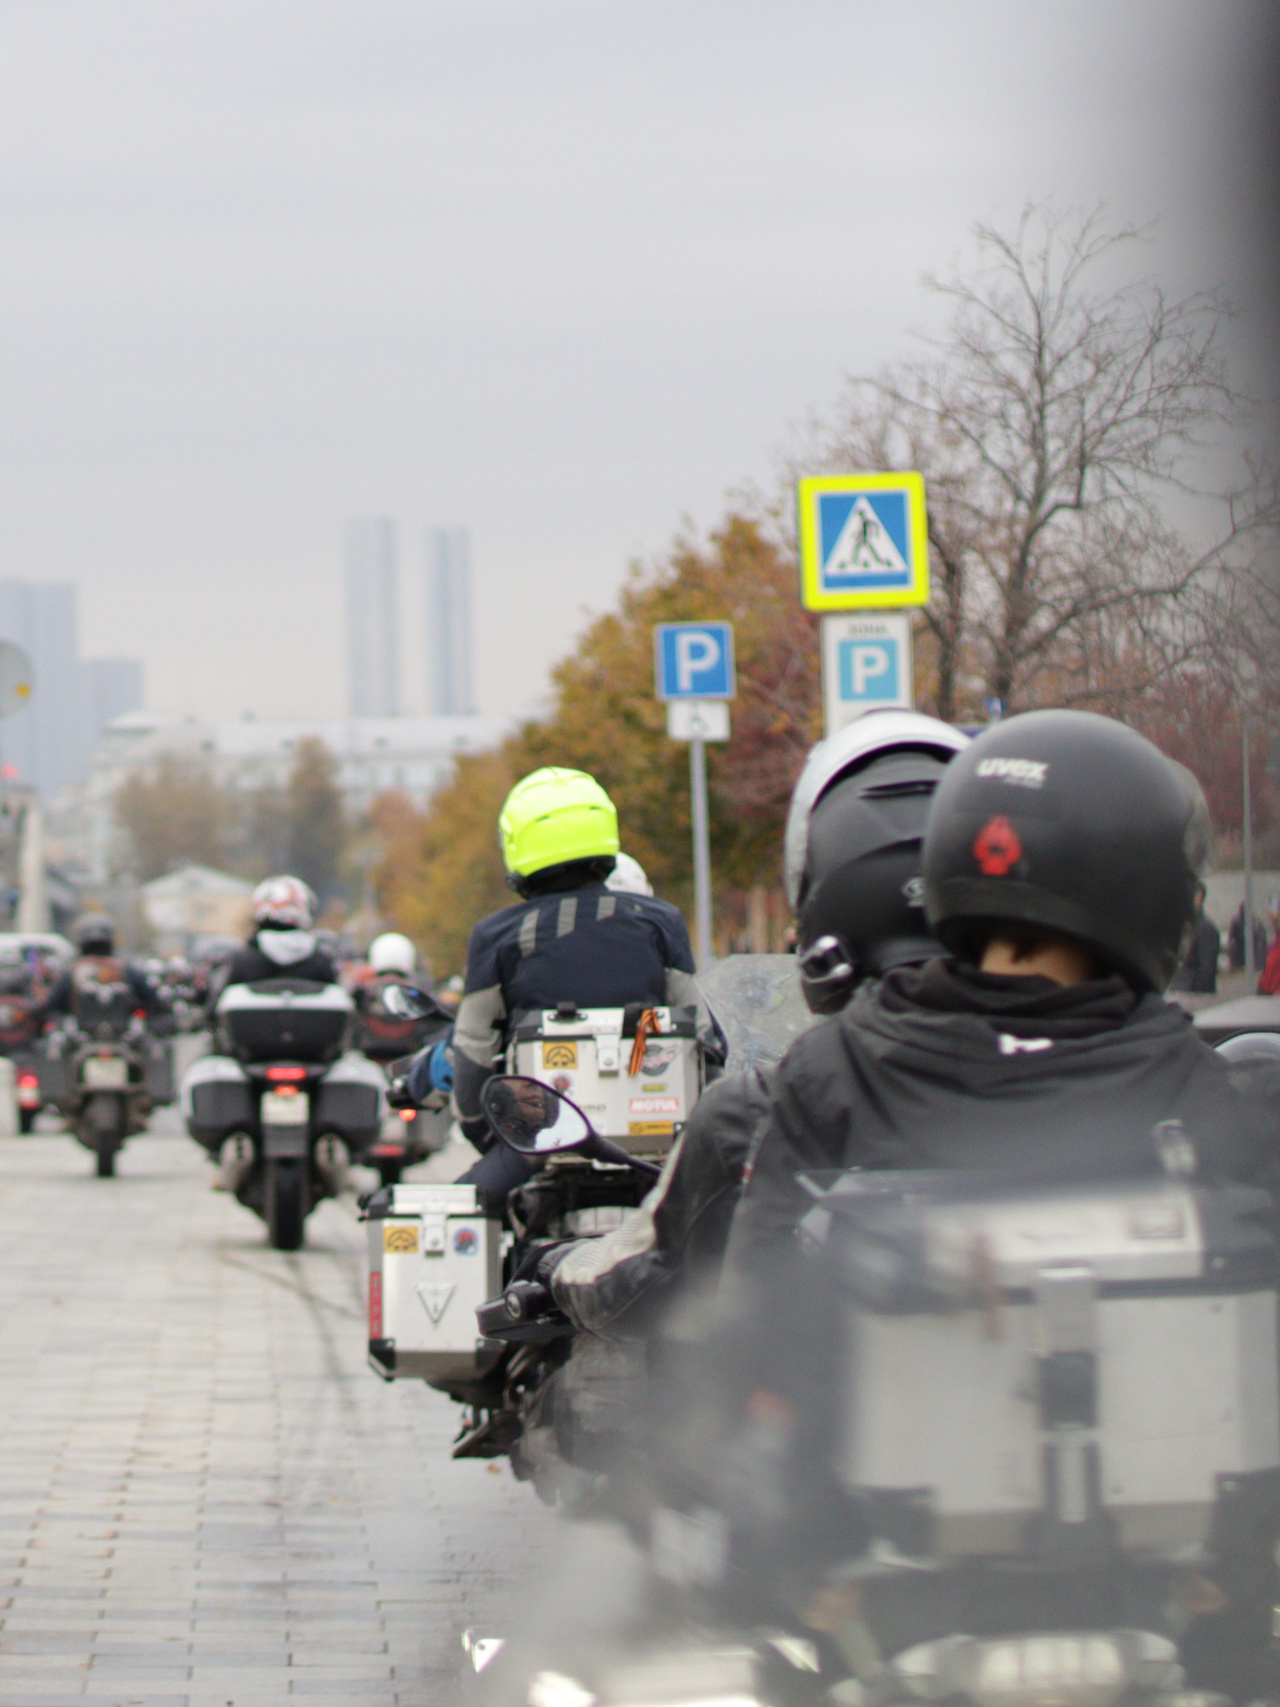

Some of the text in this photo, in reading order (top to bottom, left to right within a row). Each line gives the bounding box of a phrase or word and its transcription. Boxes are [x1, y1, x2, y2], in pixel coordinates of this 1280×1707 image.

[676, 632, 720, 691] P
[851, 646, 889, 694] P
[977, 758, 1048, 780] uvex
